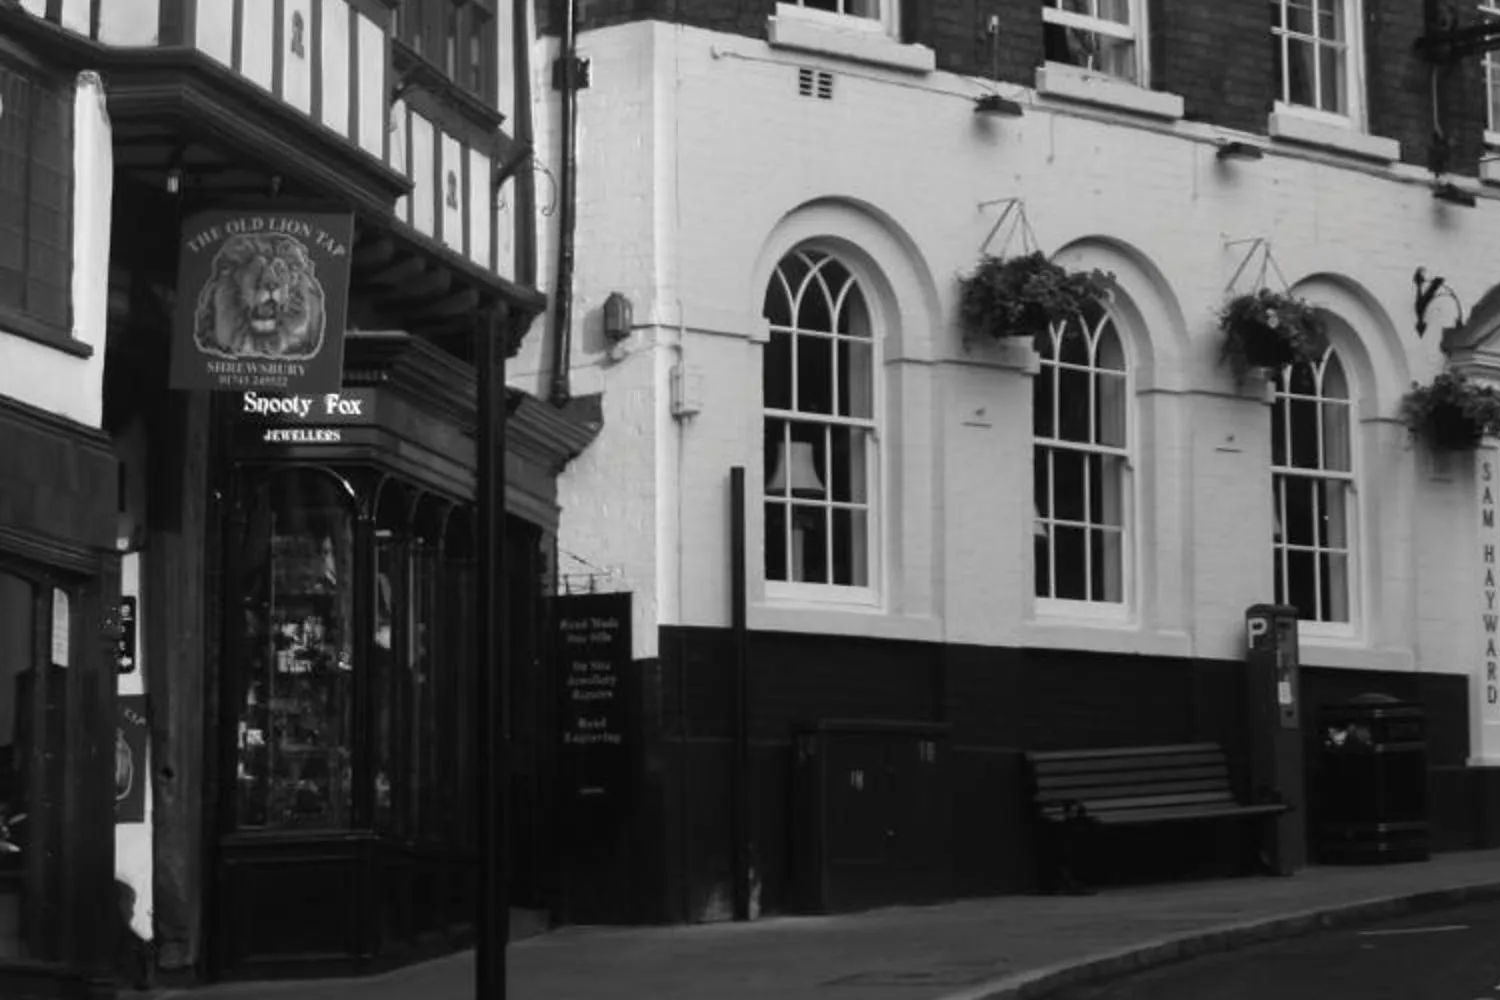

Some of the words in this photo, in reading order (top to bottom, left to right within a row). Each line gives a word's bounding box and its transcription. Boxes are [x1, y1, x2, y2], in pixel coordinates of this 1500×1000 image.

[187, 226, 222, 254] THE
[225, 216, 264, 234] OLD
[268, 216, 313, 239] LION
[314, 228, 347, 257] TAP
[206, 360, 306, 377] SHREWSBURY
[243, 390, 313, 418] Snooty
[323, 391, 362, 416] Fox
[262, 428, 342, 443] JEWELLERS
[1481, 461, 1495, 528] SAM
[1247, 616, 1268, 649] P
[1482, 543, 1499, 705] HAYWARD
